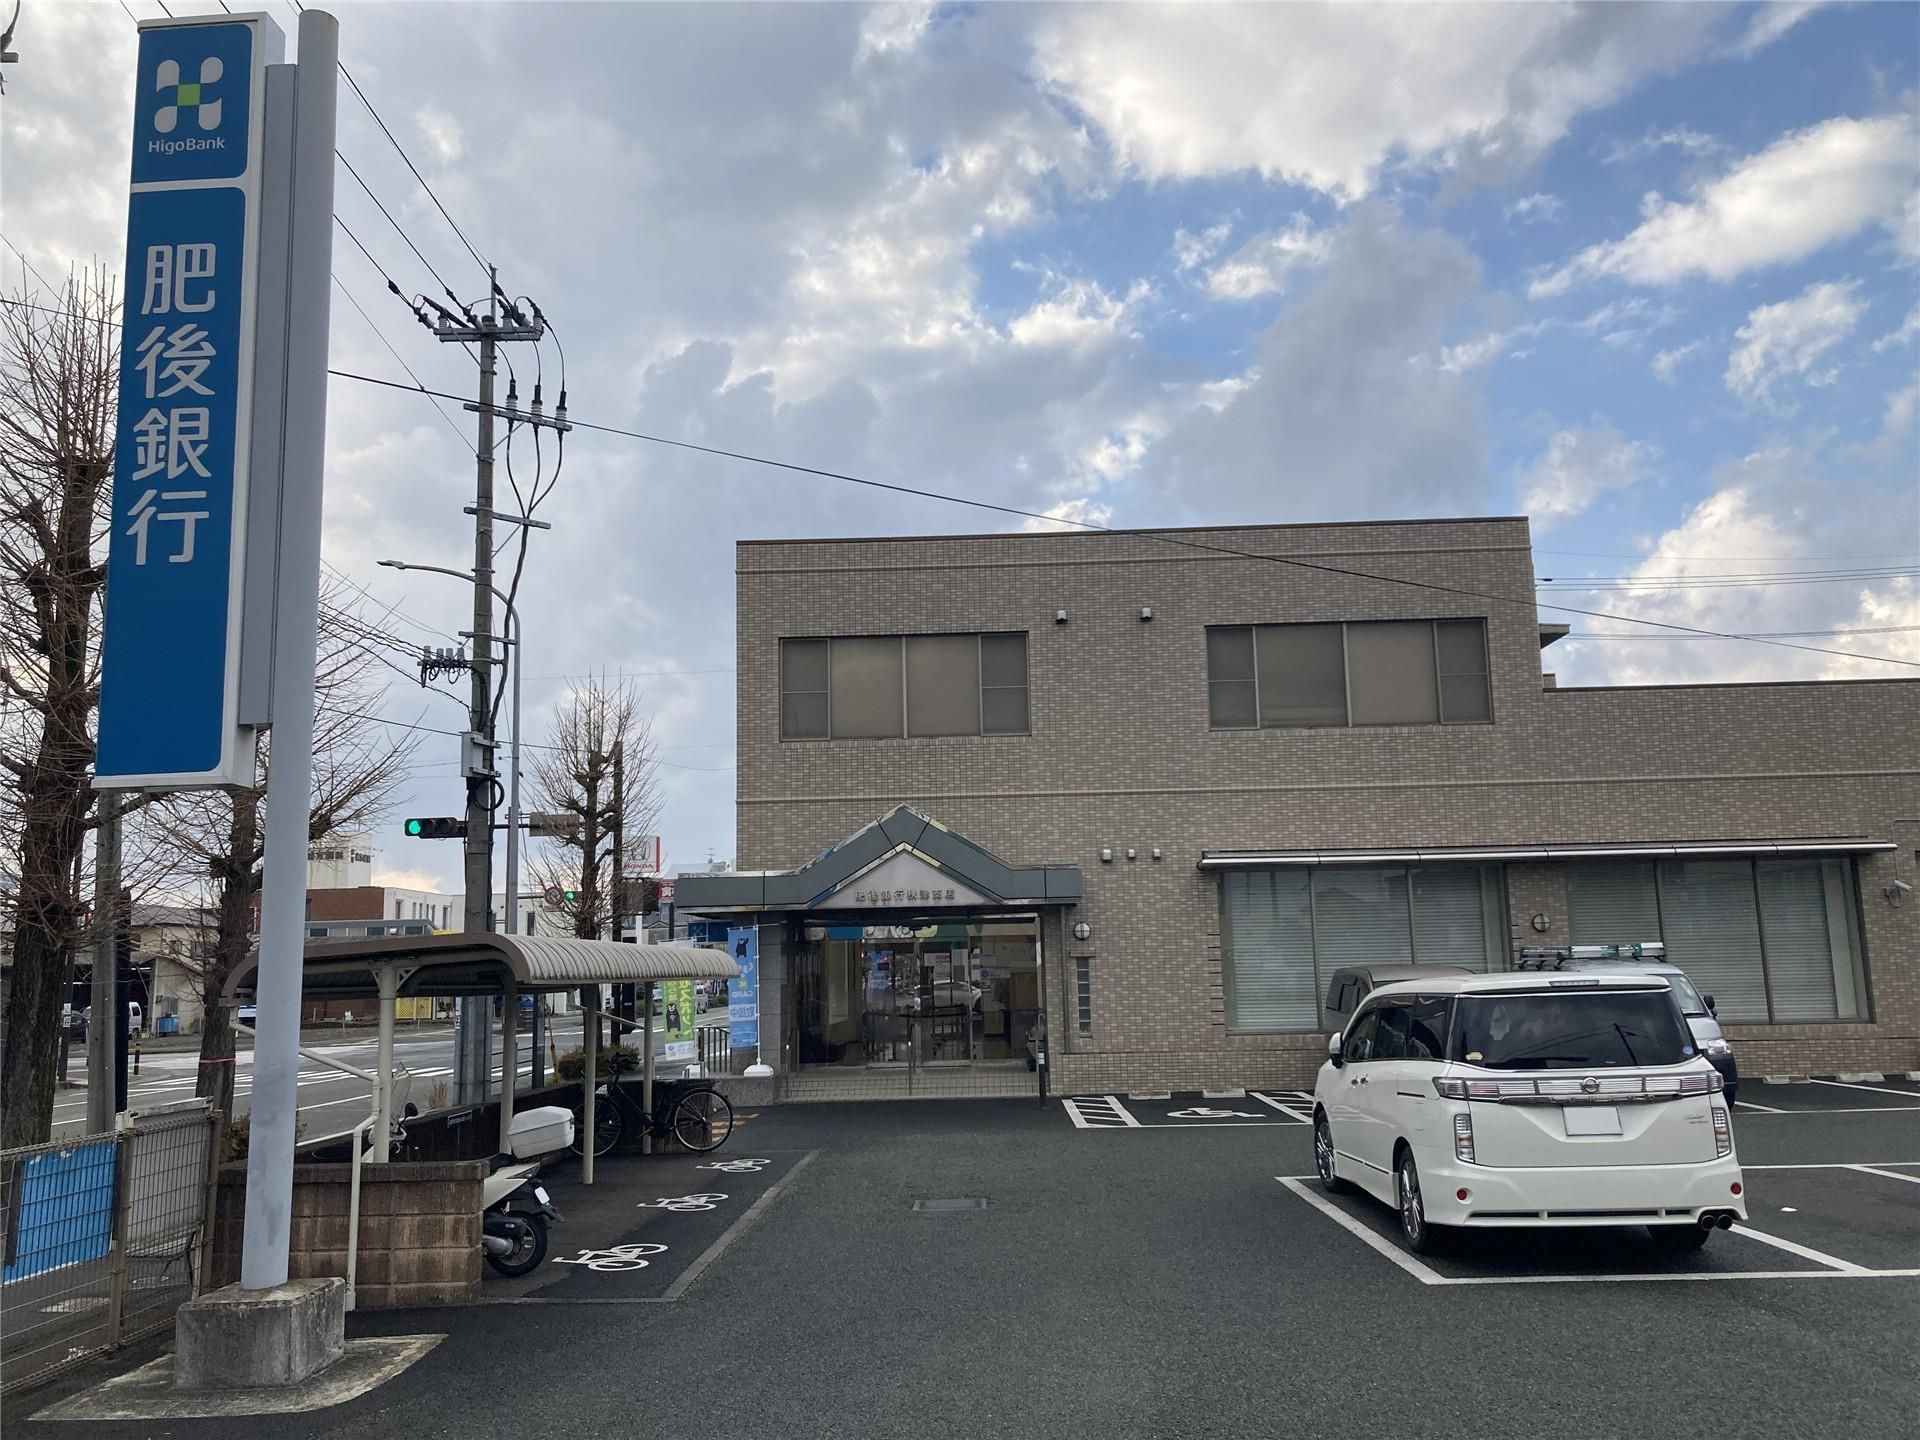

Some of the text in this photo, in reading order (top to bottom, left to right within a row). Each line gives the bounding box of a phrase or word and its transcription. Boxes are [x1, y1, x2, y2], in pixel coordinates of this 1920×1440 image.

[148, 137, 225, 155] HigoBank
[126, 243, 216, 566] 肥後銀行
